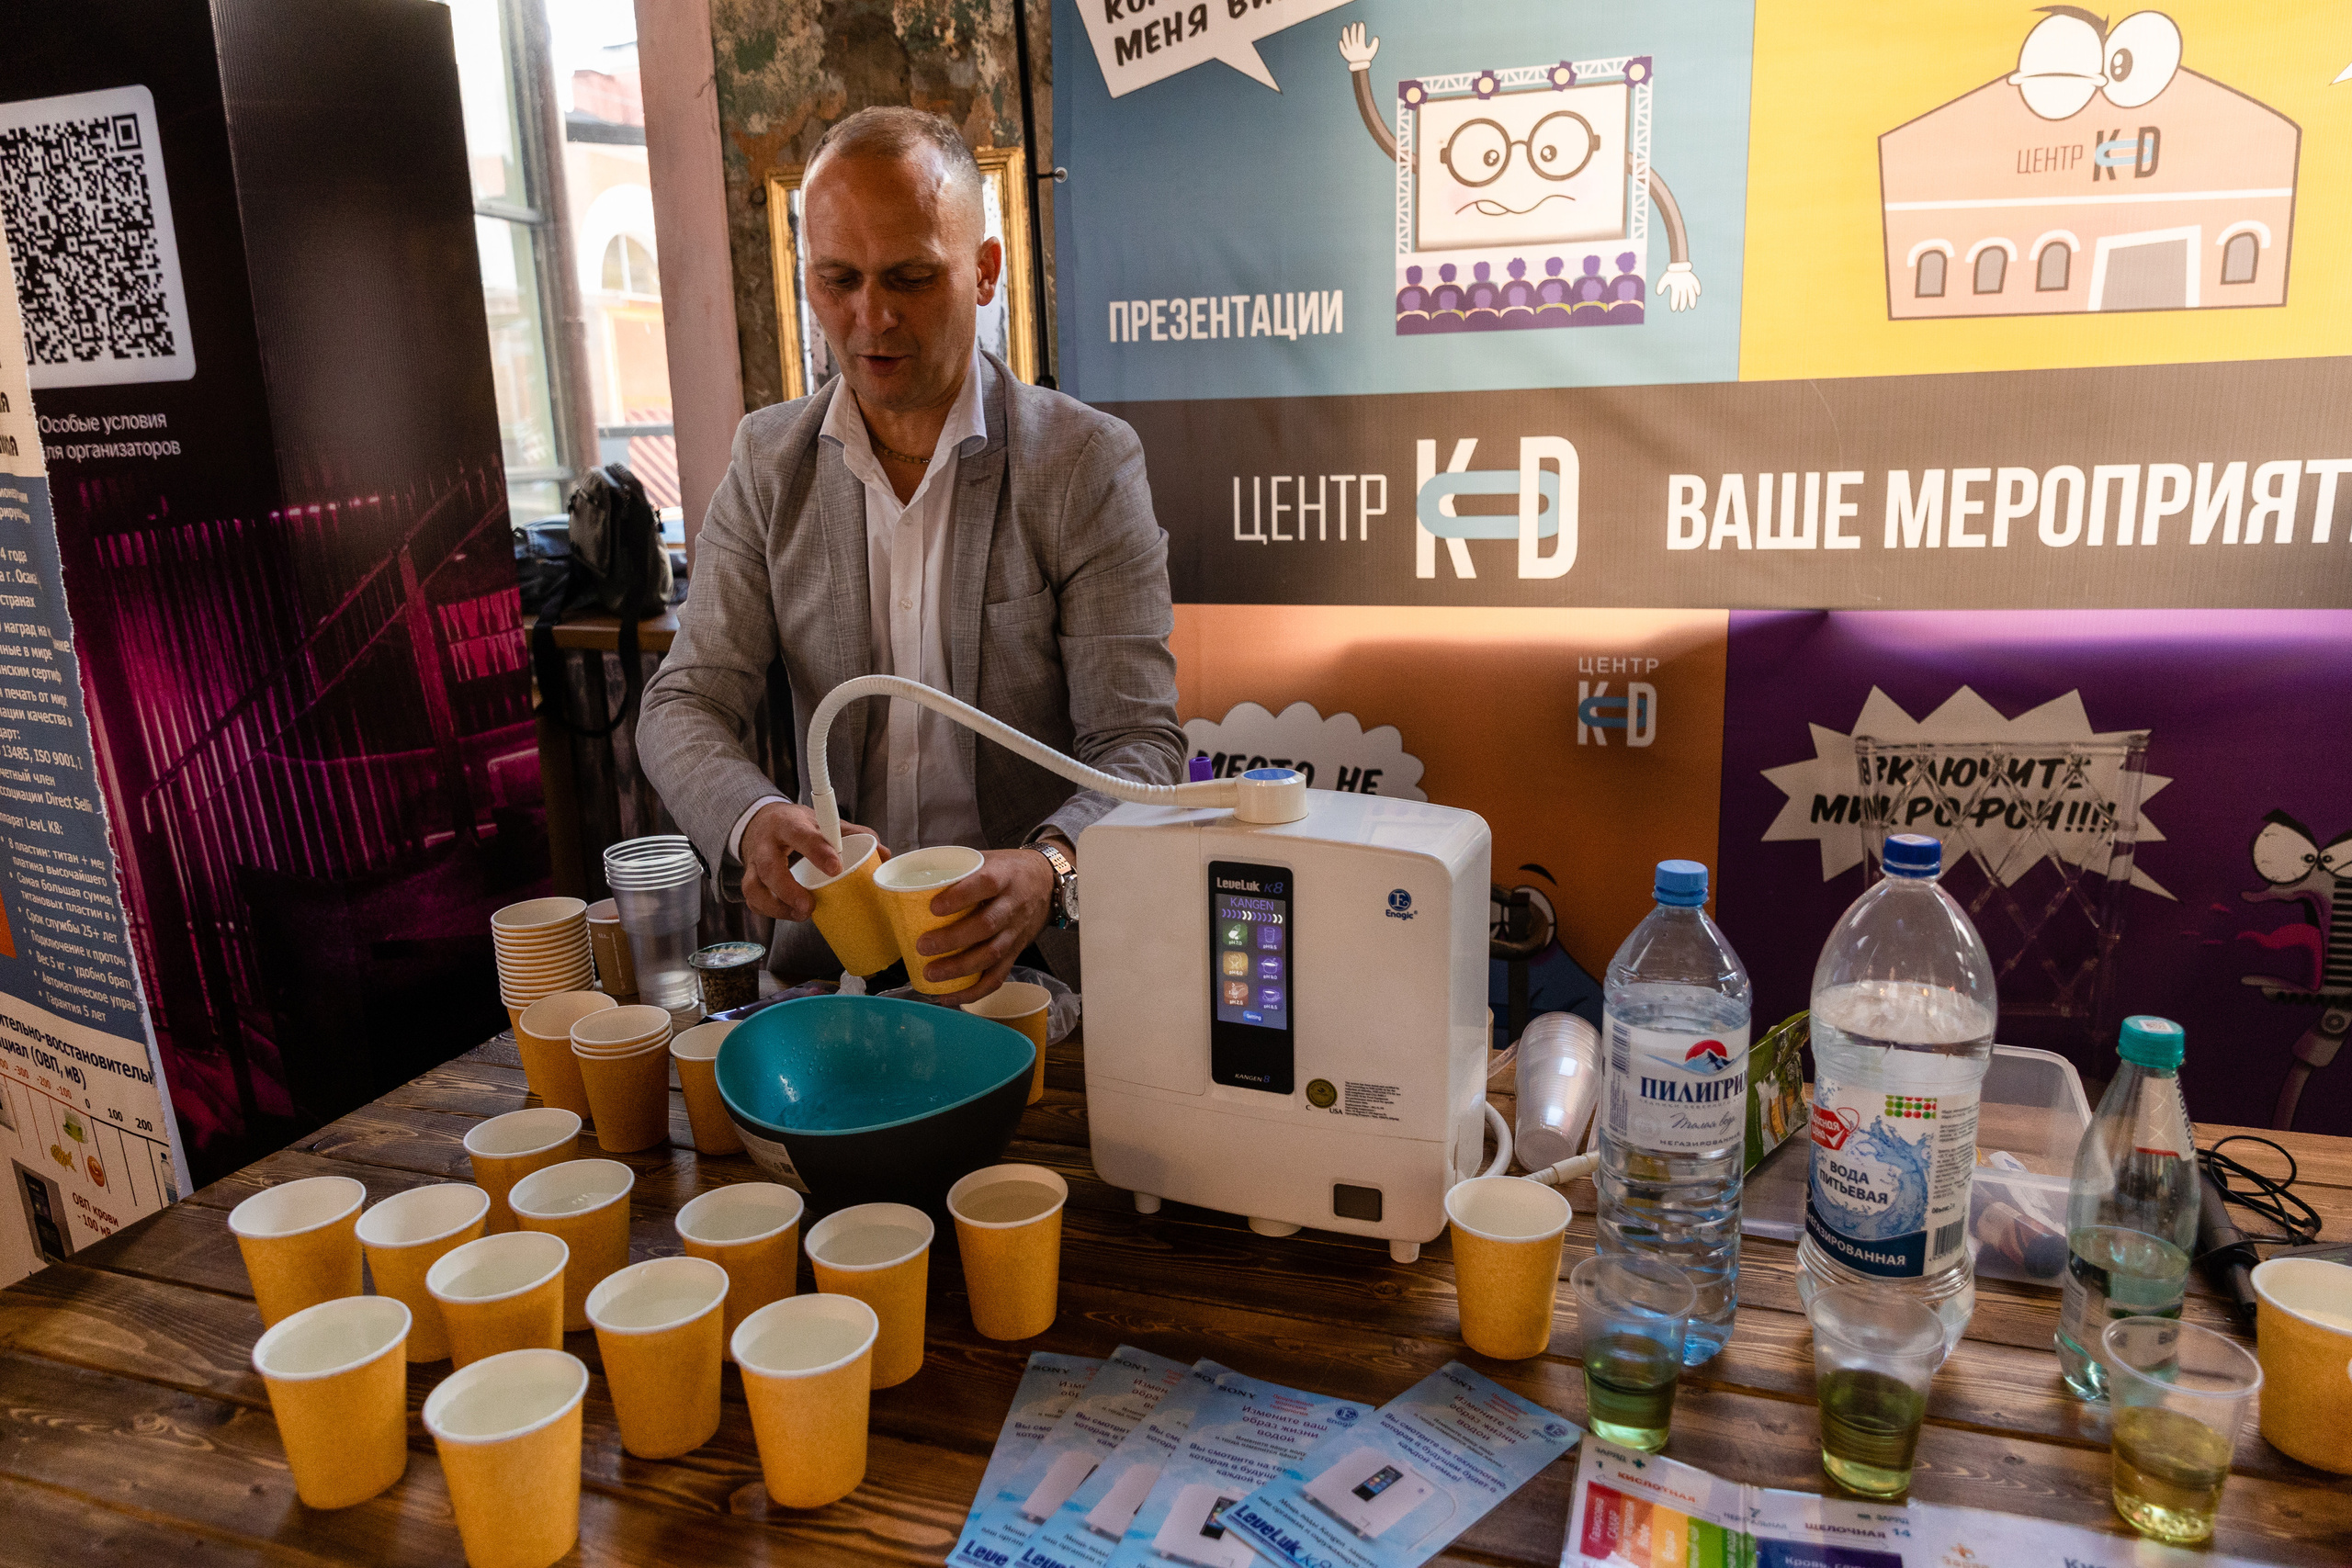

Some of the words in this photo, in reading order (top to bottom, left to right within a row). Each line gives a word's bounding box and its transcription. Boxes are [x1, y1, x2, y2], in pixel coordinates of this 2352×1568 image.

[1114, 4, 1208, 67] МЕНЯ
[2017, 144, 2084, 175] ЦЕНТР
[1109, 289, 1344, 343] ПРЕЗЕНТАЦИИ
[40, 413, 100, 434] Особые
[104, 412, 168, 435] условия
[45, 444, 63, 461] ля
[65, 440, 181, 463] организаторов
[1232, 473, 1388, 546] ЦЕНТР
[1666, 470, 1865, 550] ВАШЕ
[1883, 457, 2352, 549] МЕРОПРИЯТ
[31, 647, 53, 662] мире
[1578, 656, 1660, 676] ЦЕНТР
[5, 687, 38, 701] печать
[39, 692, 49, 704] от
[28, 710, 66, 727] качества
[2, 744, 33, 763] 13485,
[34, 748, 51, 763] ISO
[52, 751, 79, 771] 9001,
[33, 773, 56, 787] член
[1336, 764, 1384, 795] НЕ
[46, 791, 74, 810] Direct
[15, 841, 51, 859] пластин:
[52, 850, 80, 864] титан
[13, 856, 45, 874] платина
[46, 866, 108, 887] высочайшего
[17, 872, 40, 888] Самая
[40, 878, 82, 898] большая
[1263, 882, 1283, 895] K8
[20, 889, 64, 910] титановых
[65, 902, 103, 919] пластин
[1230, 897, 1274, 911] KANGEN
[26, 908, 45, 925] Срок
[45, 919, 81, 935] службы
[102, 931, 119, 944] лет
[30, 929, 86, 957] Подключение
[36, 950, 50, 965] Вес
[74, 965, 107, 984] удобно
[42, 970, 109, 1004] Автоматическое
[46, 990, 83, 1016] Гарантия
[91, 1009, 107, 1022] лет
[31, 1045, 63, 1079] (ОВП,
[1235, 1073, 1263, 1083] KANGEN
[1640, 1069, 1747, 1103] ПИЛИГРИ
[107, 1108, 124, 1122] 100
[135, 1117, 153, 1133] 200
[1659, 1131, 1741, 1147] НЕГАЗИРОВАННАЯ
[1830, 1160, 1871, 1185] ВОДА
[1820, 1168, 1888, 1205] ПИТЬЕВАЯ
[73, 1191, 92, 1210] ОВП
[93, 1204, 119, 1228] крови
[1806, 1213, 1906, 1266] НЕГАЗИРОВАННАЯ
[1032, 1364, 1070, 1375] SONY
[1114, 1358, 1150, 1373] SONY
[1217, 1383, 1258, 1400] SONY
[1442, 1371, 1476, 1391] SONY
[1242, 1404, 1300, 1426] Измените
[1303, 1420, 1329, 1432] ваш
[1450, 1403, 1481, 1425] образ
[1454, 1393, 1505, 1427] Измените
[1073, 1421, 1111, 1438] которая
[1242, 1416, 1278, 1431] образ
[1281, 1425, 1319, 1439] жизни
[1257, 1427, 1295, 1444] водой
[1380, 1420, 1415, 1443] которая
[1385, 1412, 1399, 1424] Вы
[1399, 1420, 1440, 1449] смотрите
[1189, 1452, 1229, 1468] которая
[1190, 1442, 1206, 1453] Вы
[1207, 1447, 1255, 1466] смотрите
[1256, 1461, 1270, 1470] на
[1216, 1468, 1255, 1484] каждой
[1617, 1471, 1697, 1504] КИСЛОТНАЯ
[1804, 1521, 1886, 1540] ЩЕЛОЧНАЯ
[1892, 1527, 1912, 1538] 14
